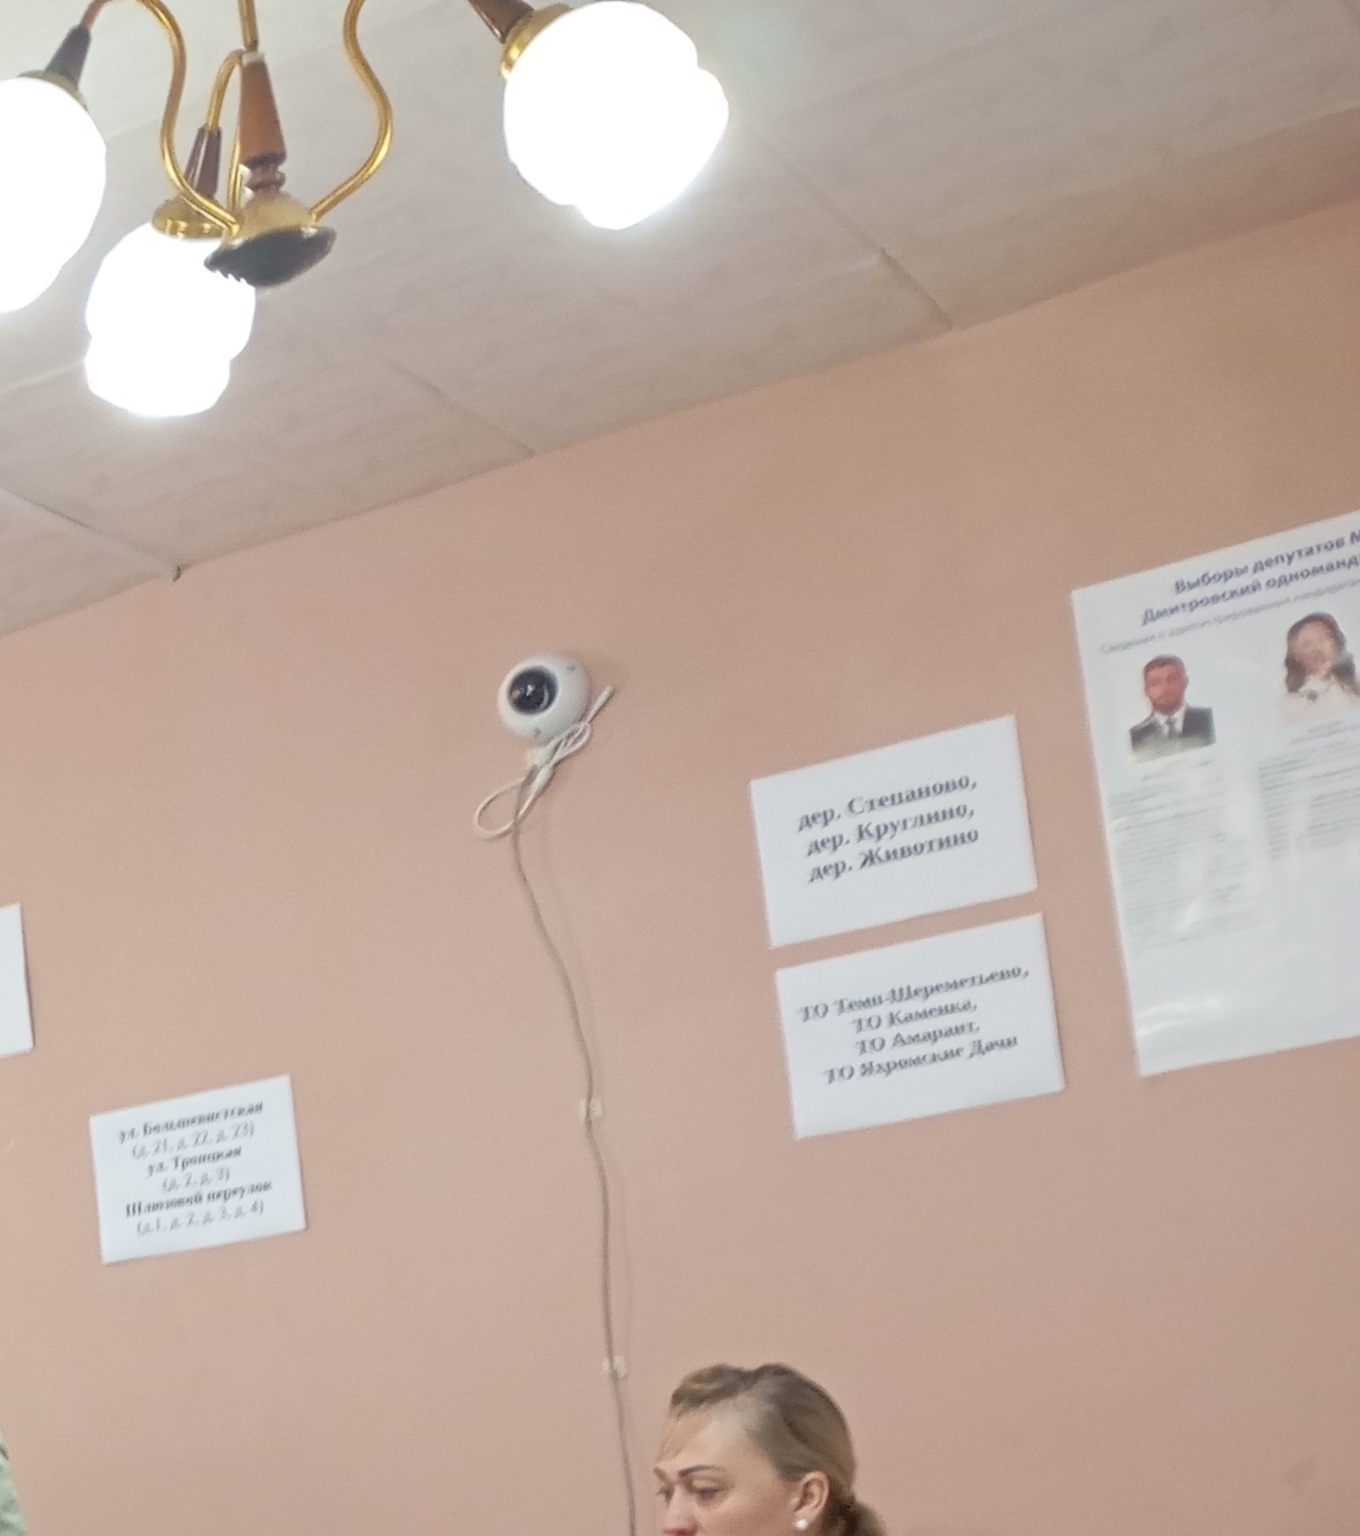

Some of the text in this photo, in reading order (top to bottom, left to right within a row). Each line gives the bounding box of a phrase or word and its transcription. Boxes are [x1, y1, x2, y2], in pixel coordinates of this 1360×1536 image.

[1141, 579, 1262, 626] Дмитровский
[1265, 553, 1360, 588] одноманд
[1173, 565, 1249, 595] Выборы
[1252, 536, 1346, 575] депутатов
[798, 775, 977, 833] дер. Степаново,
[807, 804, 975, 857] дер. Круглино,
[808, 829, 979, 884] дер. Животино
[799, 1003, 829, 1023] ТО
[851, 1000, 978, 1034] ТО Каменка,
[855, 1021, 980, 1056] ТО Амарант,
[824, 1036, 1018, 1085] ТО Яхромские Дачи
